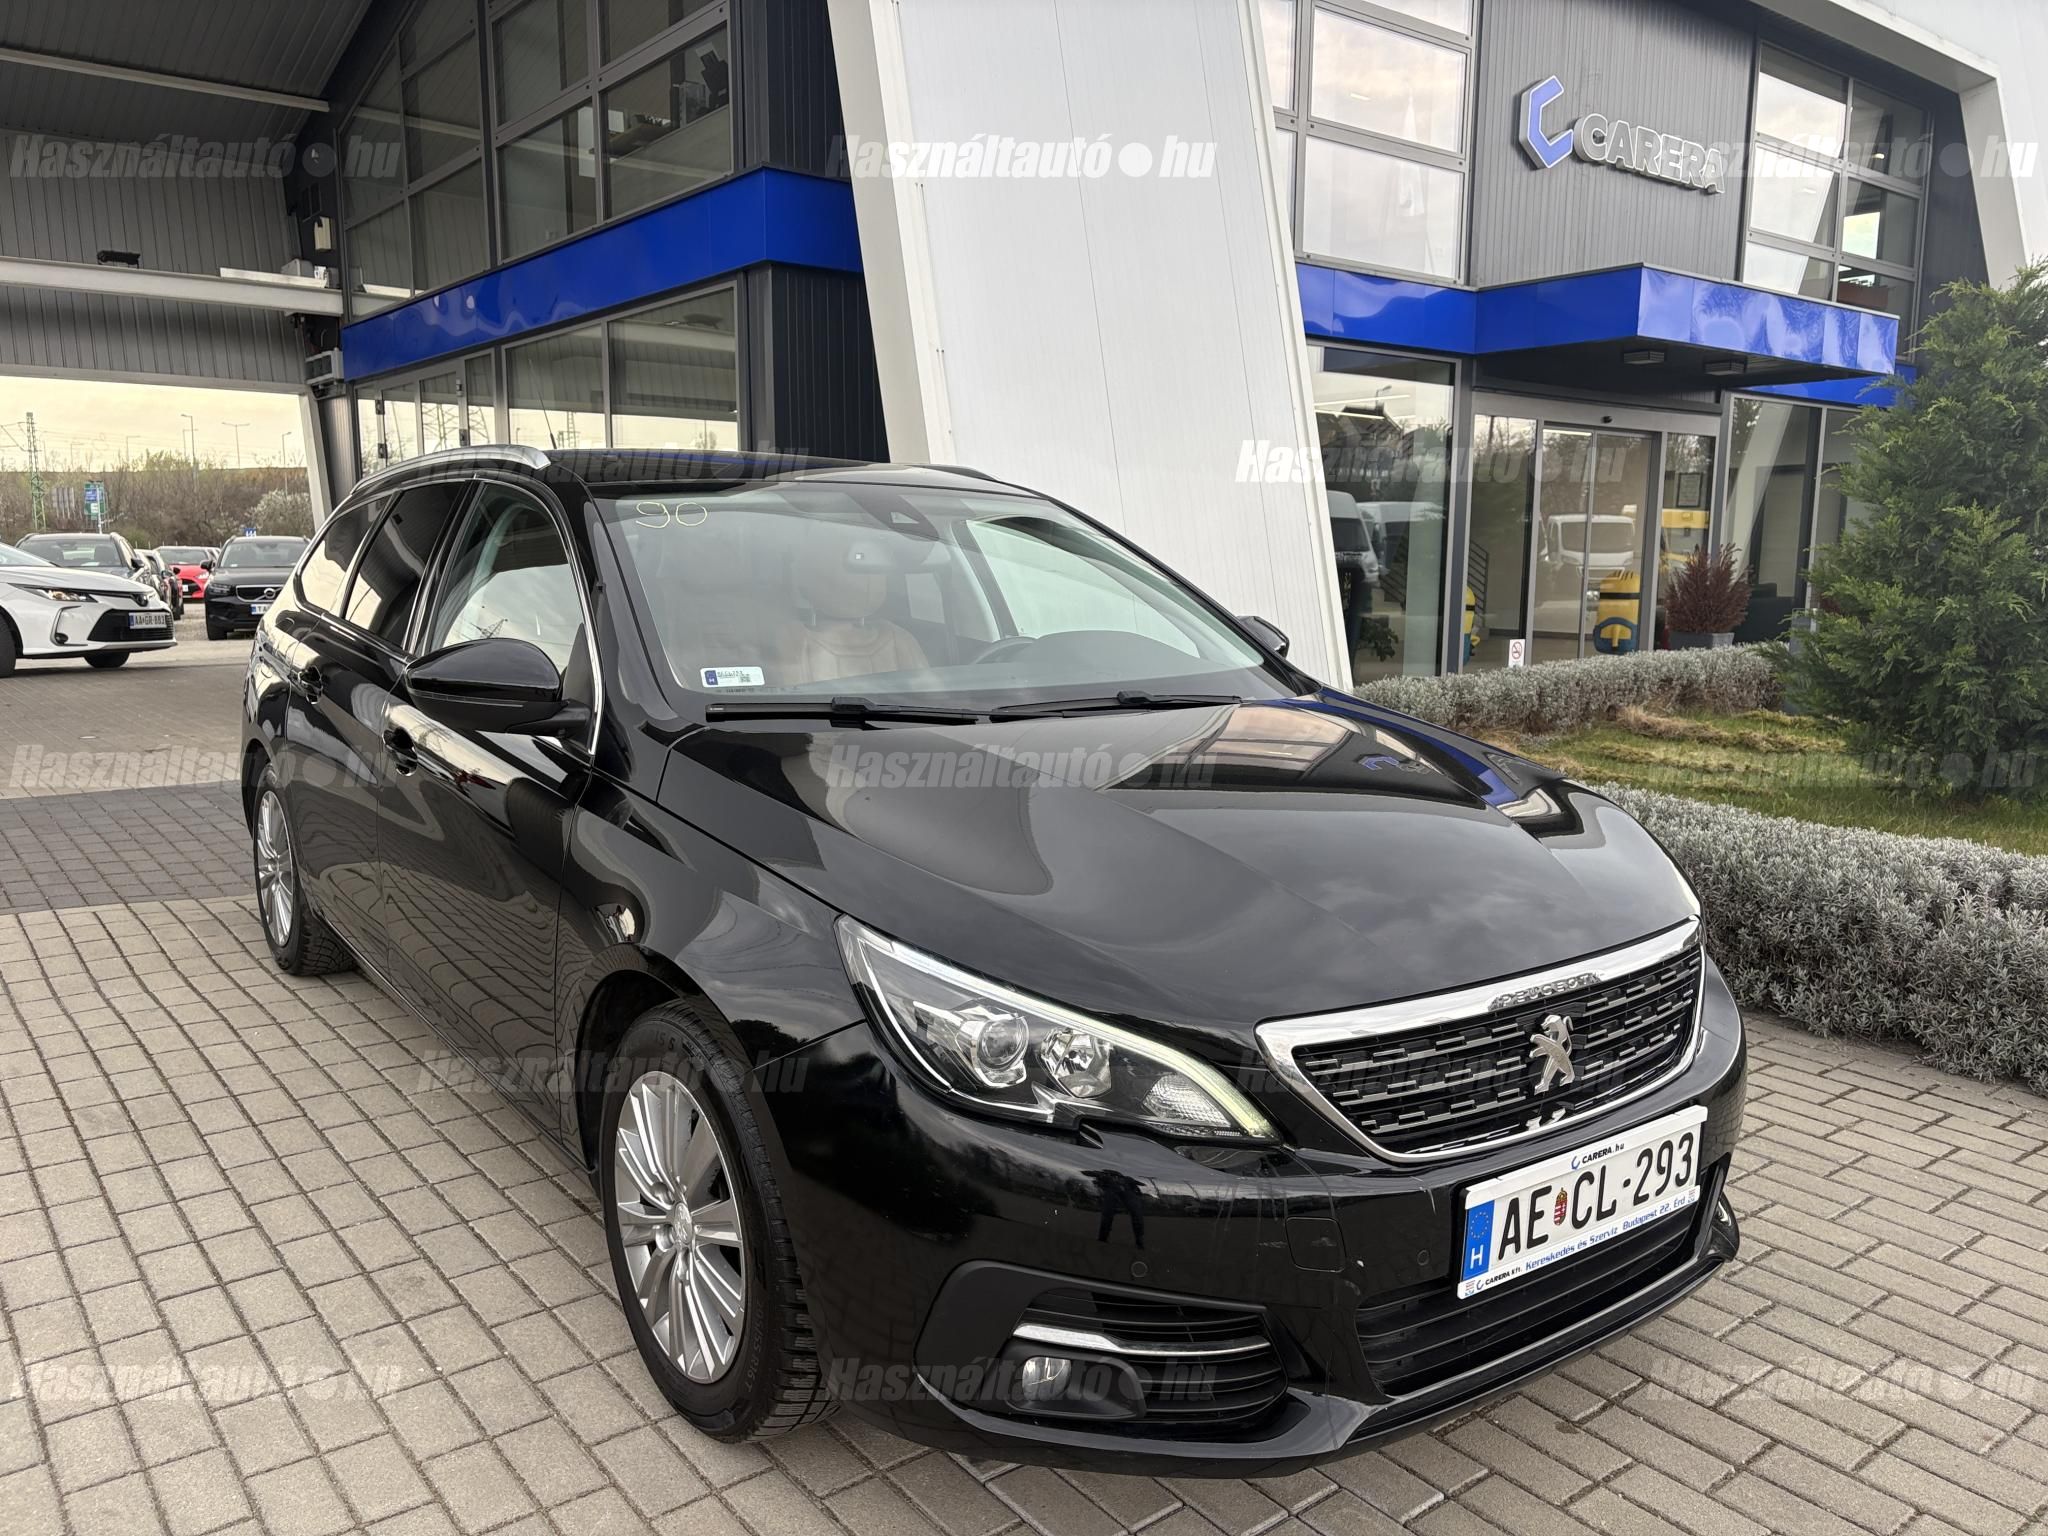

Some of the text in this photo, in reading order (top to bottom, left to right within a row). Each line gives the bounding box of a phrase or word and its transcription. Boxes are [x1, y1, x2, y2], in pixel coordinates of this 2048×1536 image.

[1575, 112, 1726, 194] CARERA
[635, 501, 708, 529] 90
[1500, 973, 1590, 1007] PEUGEOT
[1469, 1243, 1485, 1270] H
[1485, 1271, 1511, 1286] CARERA
[1525, 1245, 1576, 1272] Kereskedés
[1577, 1240, 1588, 1251] és
[1622, 1208, 1658, 1231] Budapest
